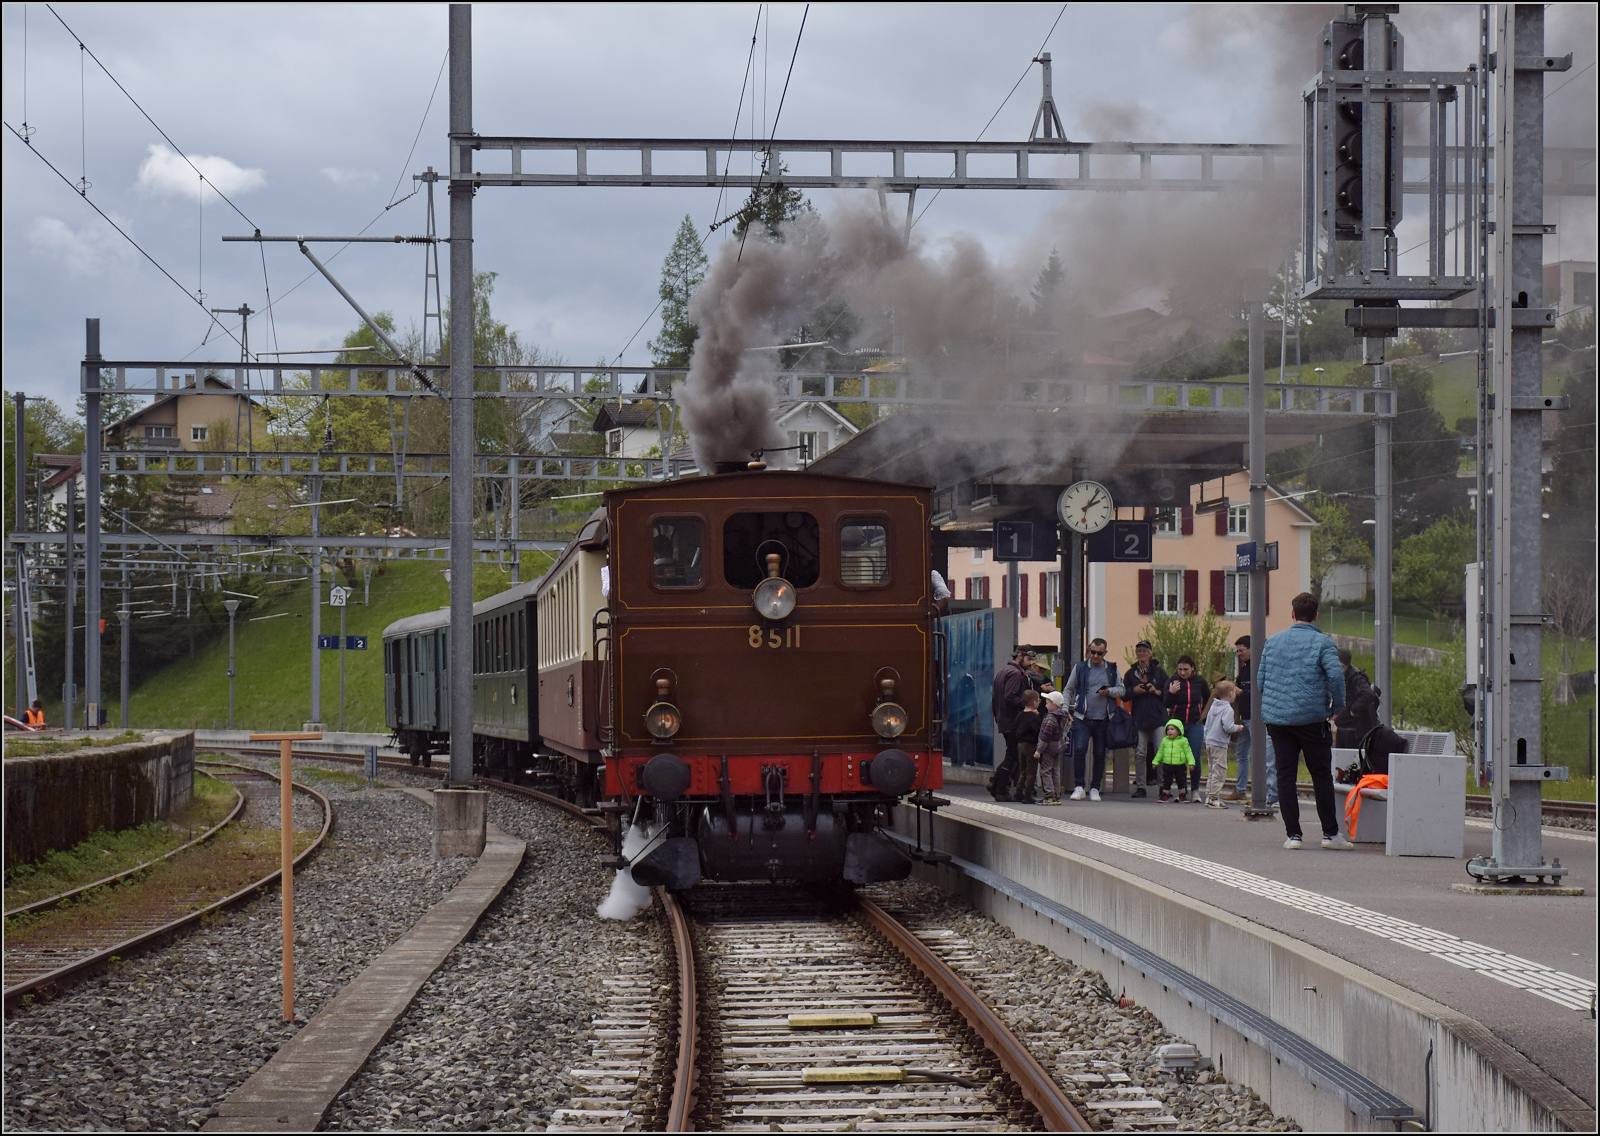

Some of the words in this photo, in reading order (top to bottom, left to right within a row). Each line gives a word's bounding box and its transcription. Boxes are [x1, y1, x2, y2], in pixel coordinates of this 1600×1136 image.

[1009, 533, 1018, 553] 1
[1124, 533, 1139, 554] 2
[333, 595, 343, 604] 75
[323, 639, 327, 647] 1
[749, 625, 800, 648] 8511
[357, 640, 363, 648] 2
